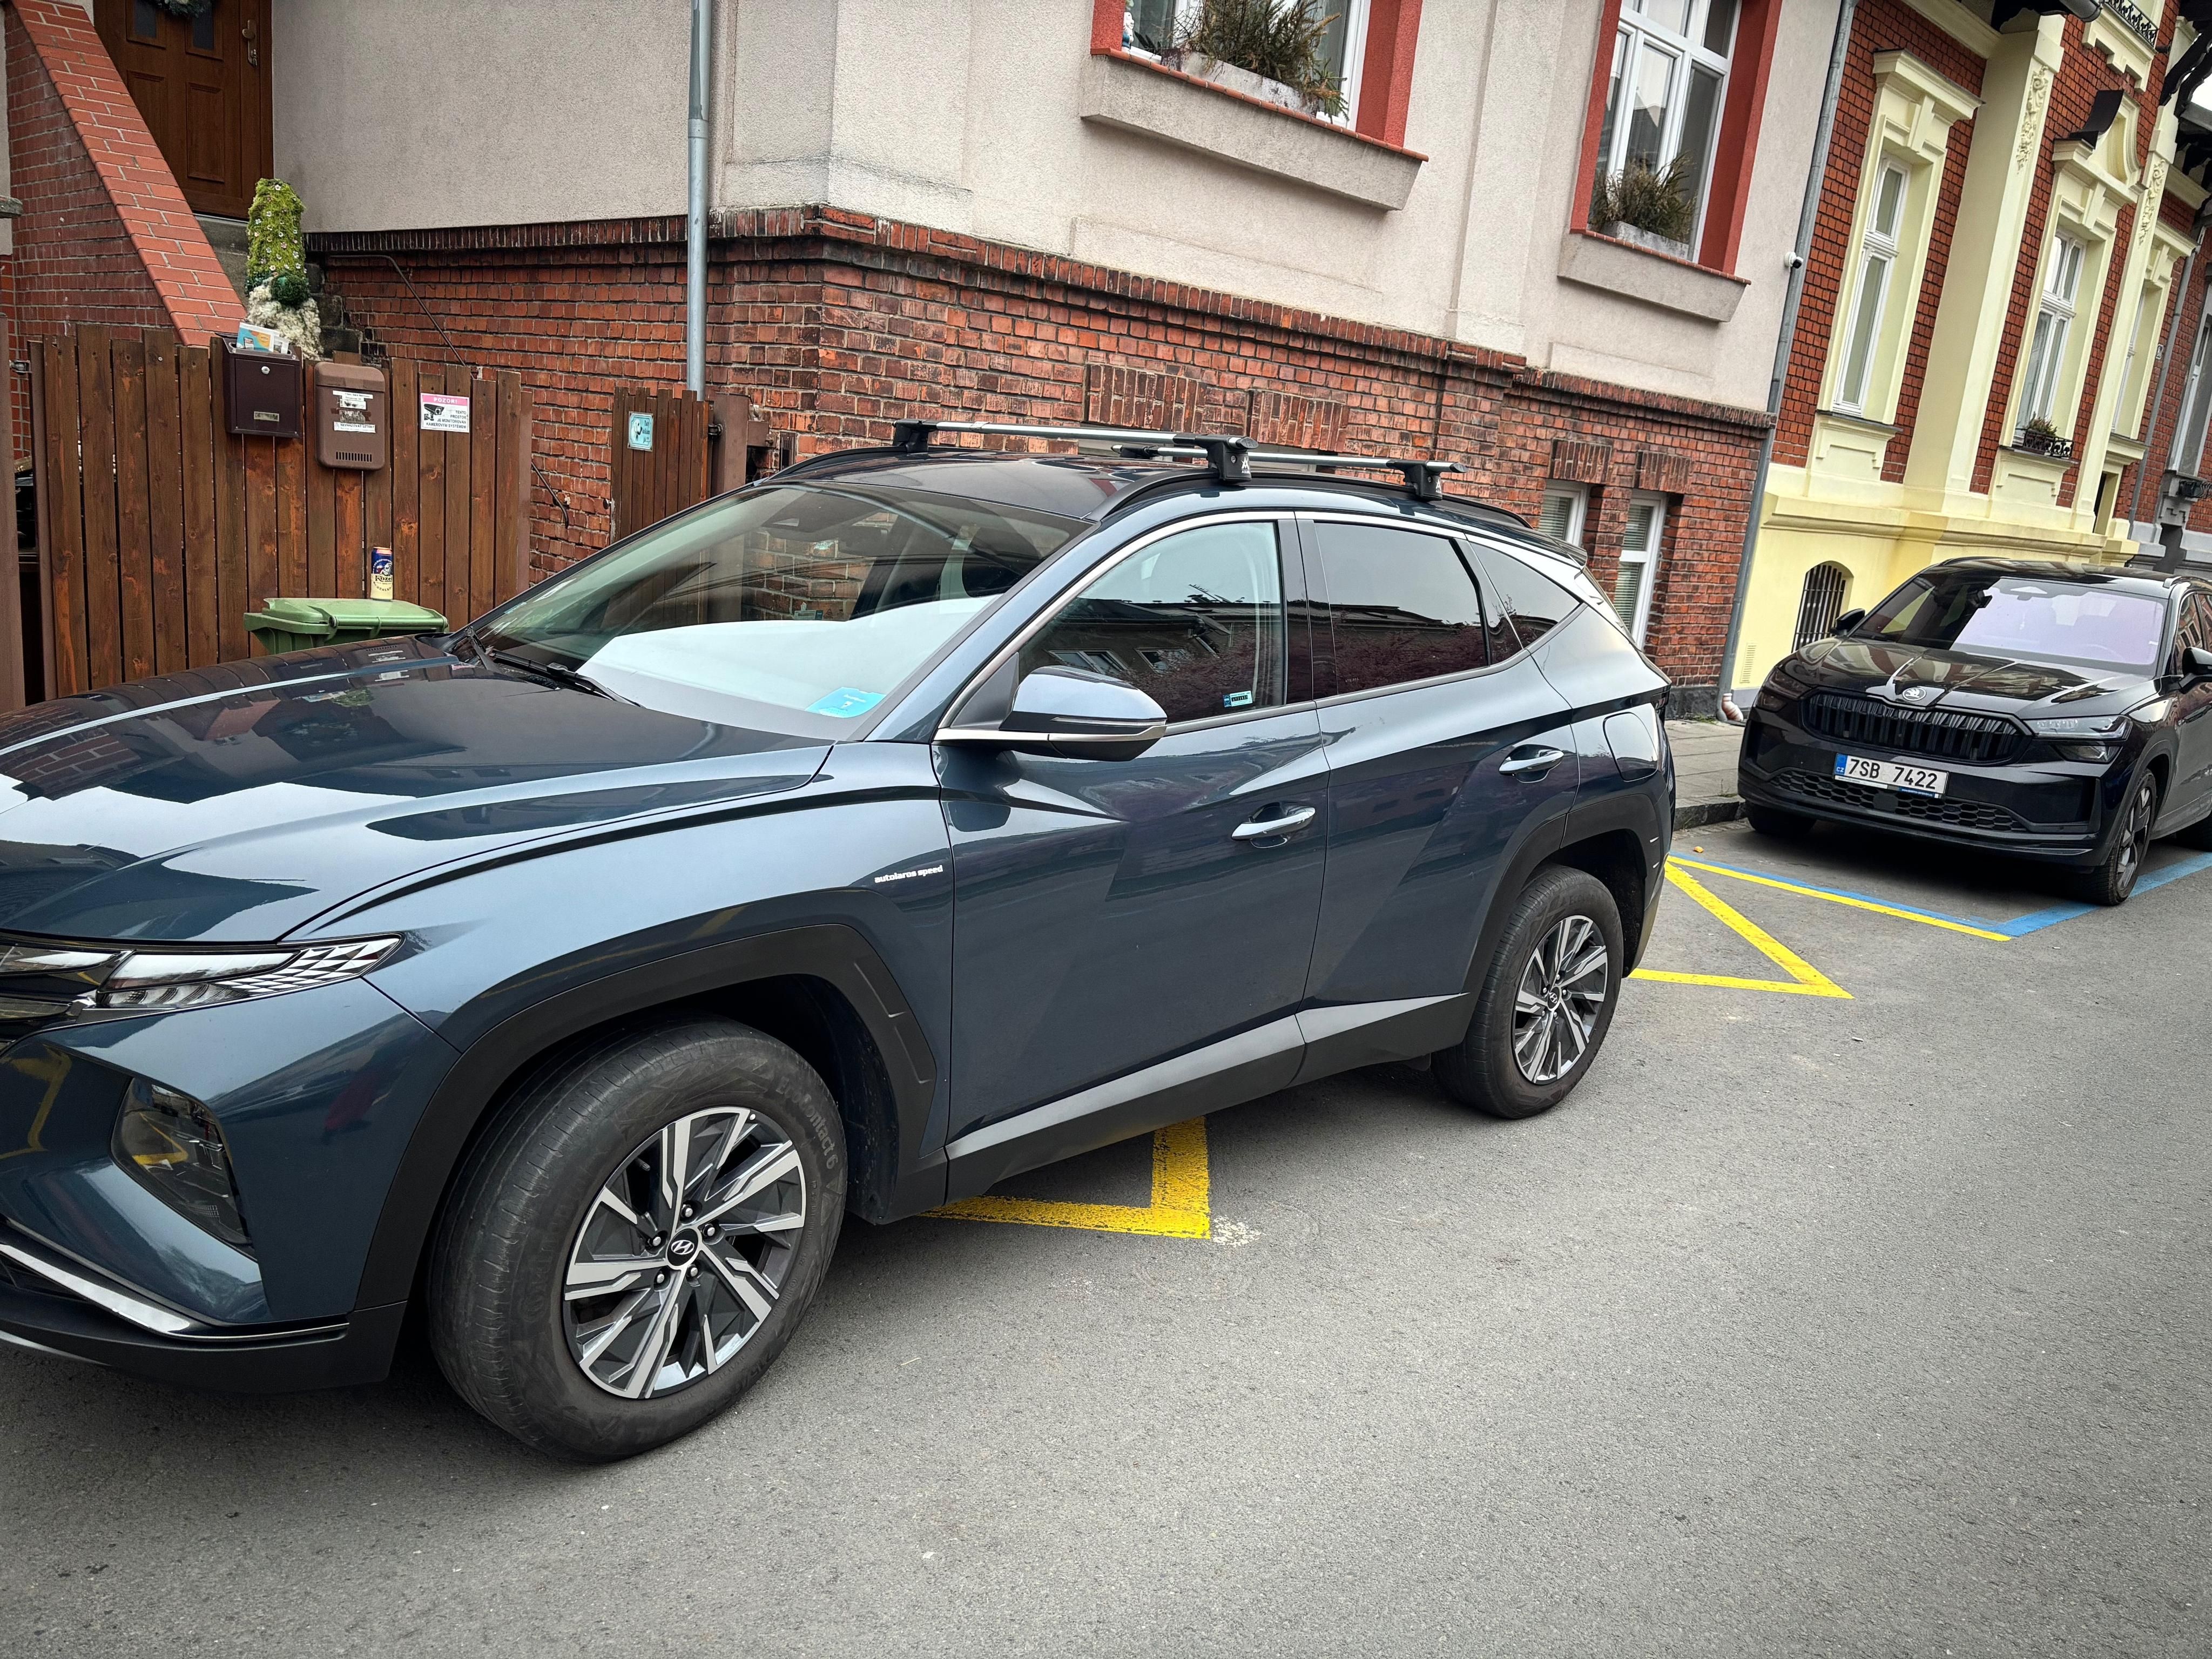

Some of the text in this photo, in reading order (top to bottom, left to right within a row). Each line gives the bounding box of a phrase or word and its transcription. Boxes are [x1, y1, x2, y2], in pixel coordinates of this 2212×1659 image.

[1849, 759, 1938, 790] 7SB 7422
[874, 865, 943, 883] autolaros speed
[826, 1154, 838, 1169] 6
